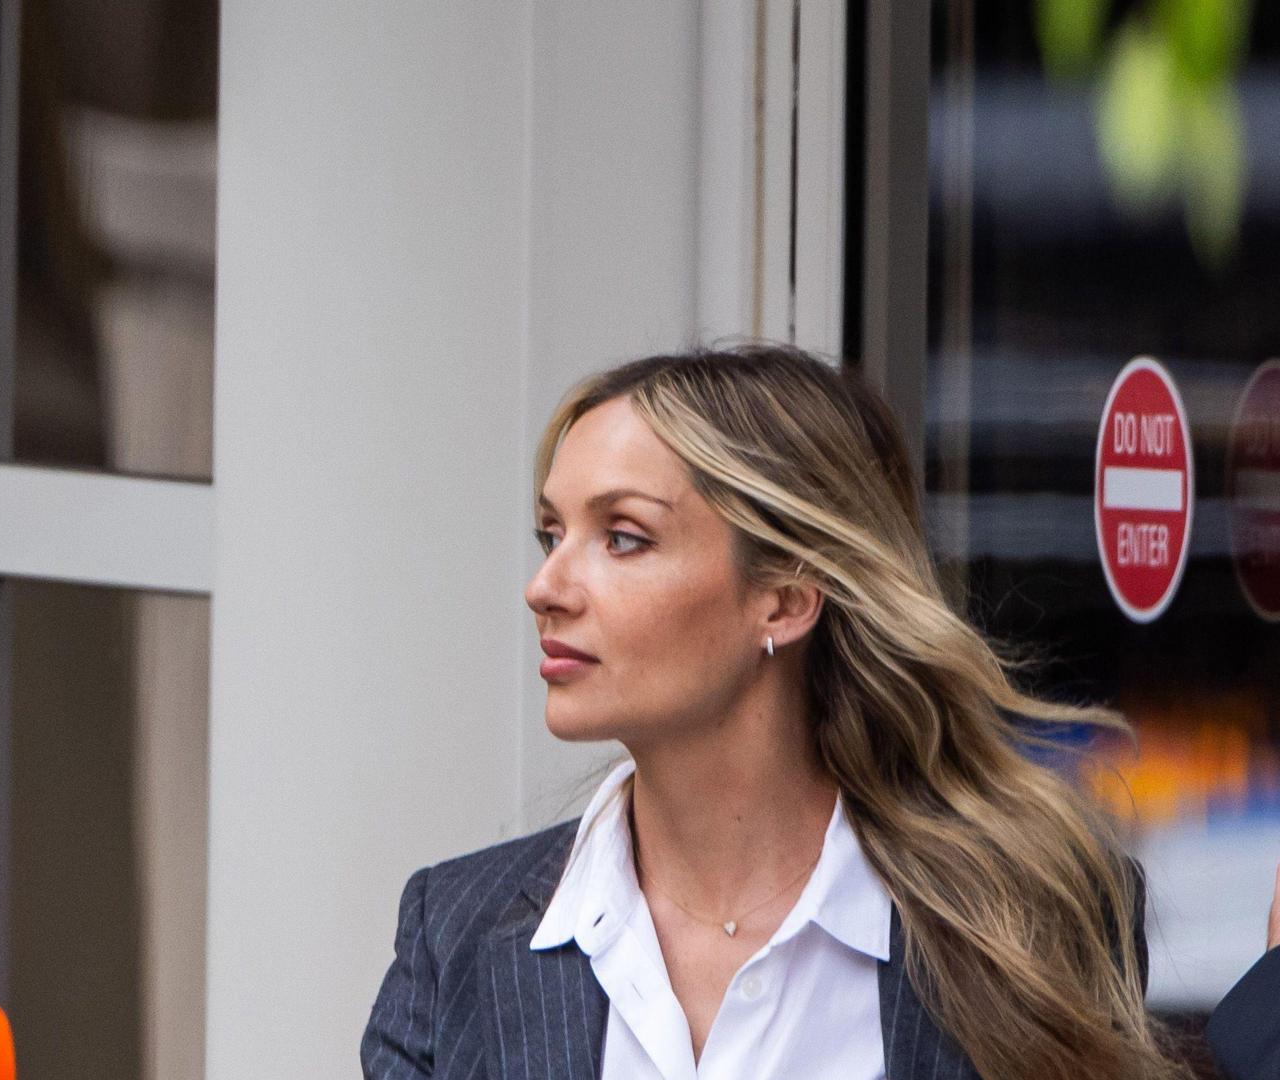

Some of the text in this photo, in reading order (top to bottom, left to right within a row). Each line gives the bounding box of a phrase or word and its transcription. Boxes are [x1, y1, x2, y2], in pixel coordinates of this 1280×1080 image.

[1114, 412, 1174, 456] DO NOT
[1117, 523, 1169, 567] ENTER
